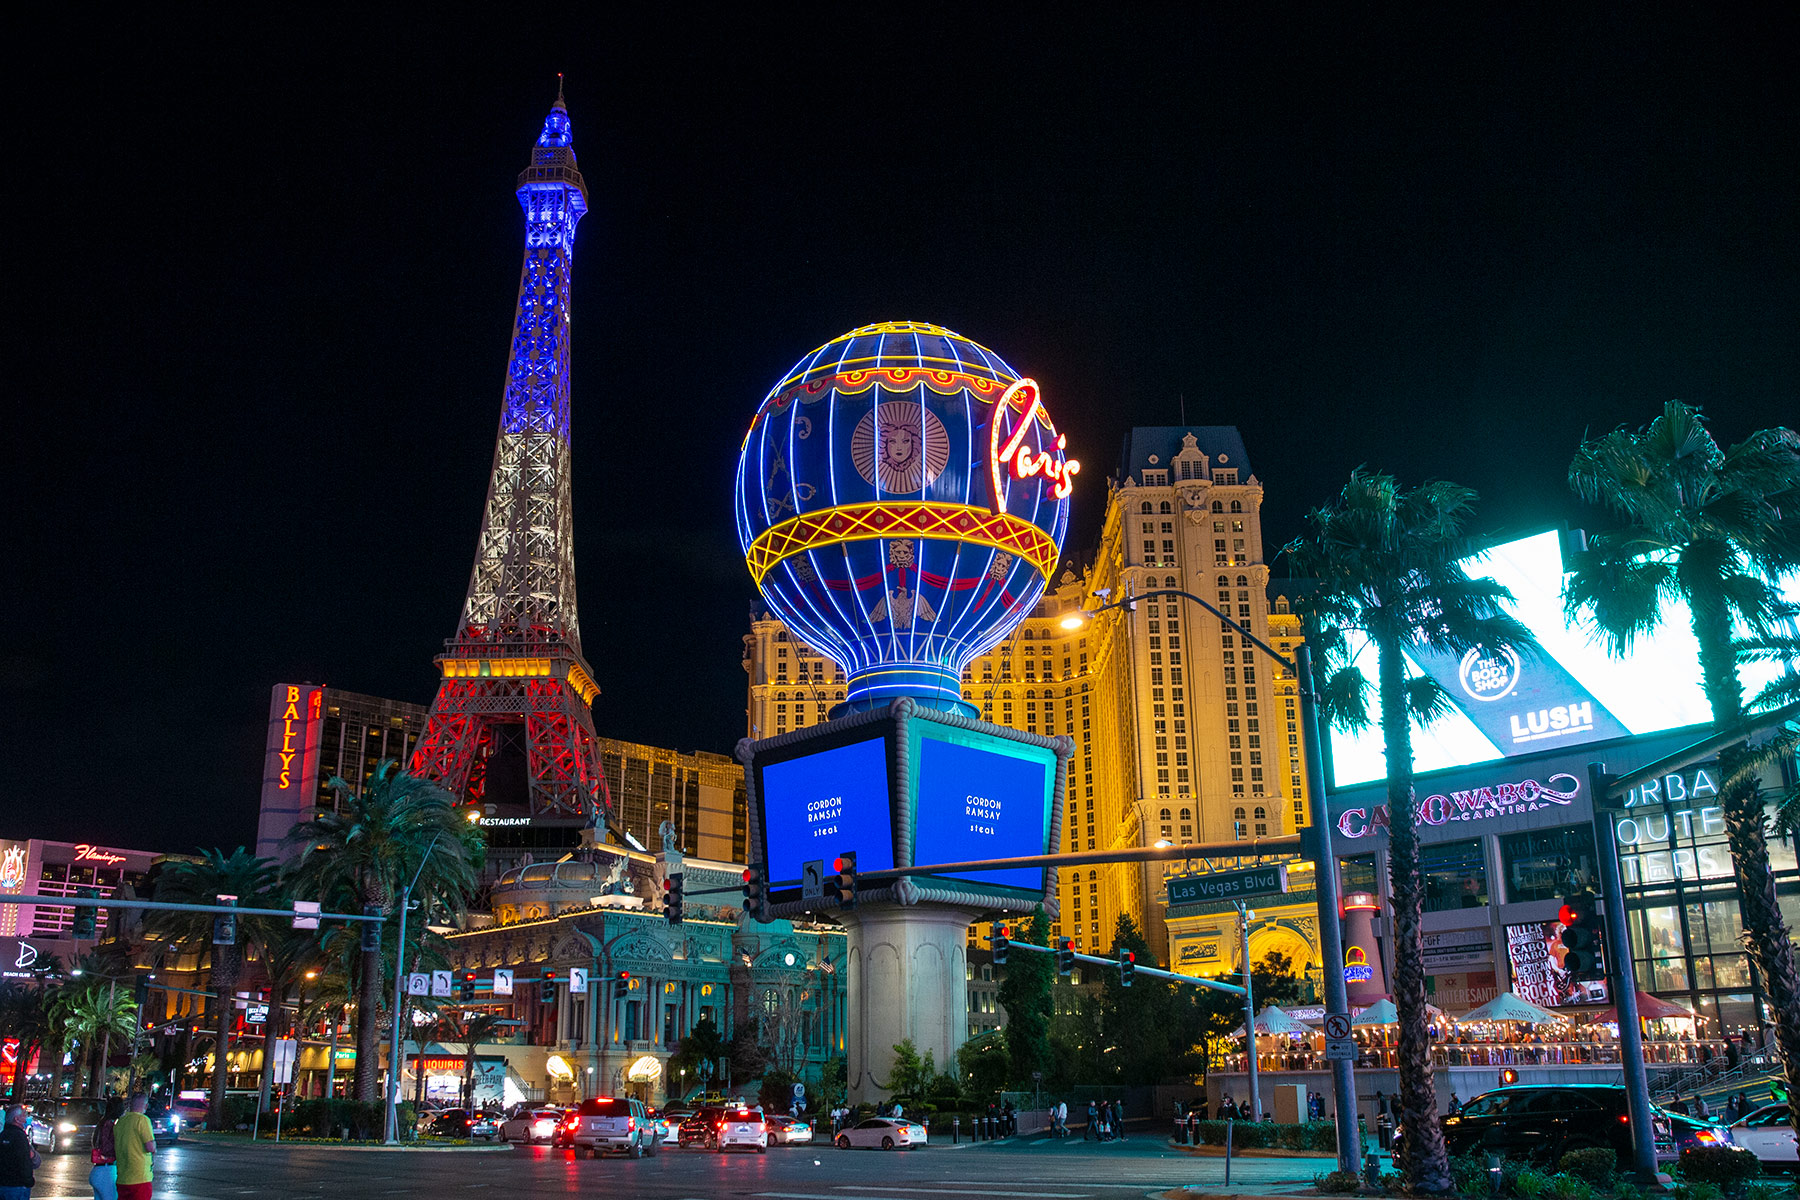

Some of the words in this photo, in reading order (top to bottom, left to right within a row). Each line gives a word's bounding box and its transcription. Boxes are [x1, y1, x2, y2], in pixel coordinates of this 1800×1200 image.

[985, 377, 1080, 515] Paris
[1471, 664, 1508, 682] BODY
[1474, 676, 1509, 692] SHOP
[1509, 701, 1593, 738] LUSH
[278, 685, 300, 789] BALLYS
[966, 795, 1002, 810] GORDON
[1449, 779, 1542, 812] WABO
[808, 796, 842, 812] GORDON
[1462, 801, 1539, 821] CANTINA
[808, 807, 842, 823] RAMSAY
[965, 806, 1001, 821] RAMSAY
[74, 844, 127, 866] Flamingo
[804, 888, 820, 897] ONLY
[1172, 886, 1196, 899] Las
[1199, 880, 1240, 896] Vegas
[1244, 873, 1275, 889] Blvd
[1506, 923, 1542, 938] KILLER
[1512, 941, 1546, 955] CABO
[1513, 950, 1548, 964] WABO
[1515, 960, 1552, 977] MEXICAN
[1517, 972, 1544, 986] FOOD
[1545, 970, 1554, 982] &
[1520, 981, 1558, 1004] ROCK
